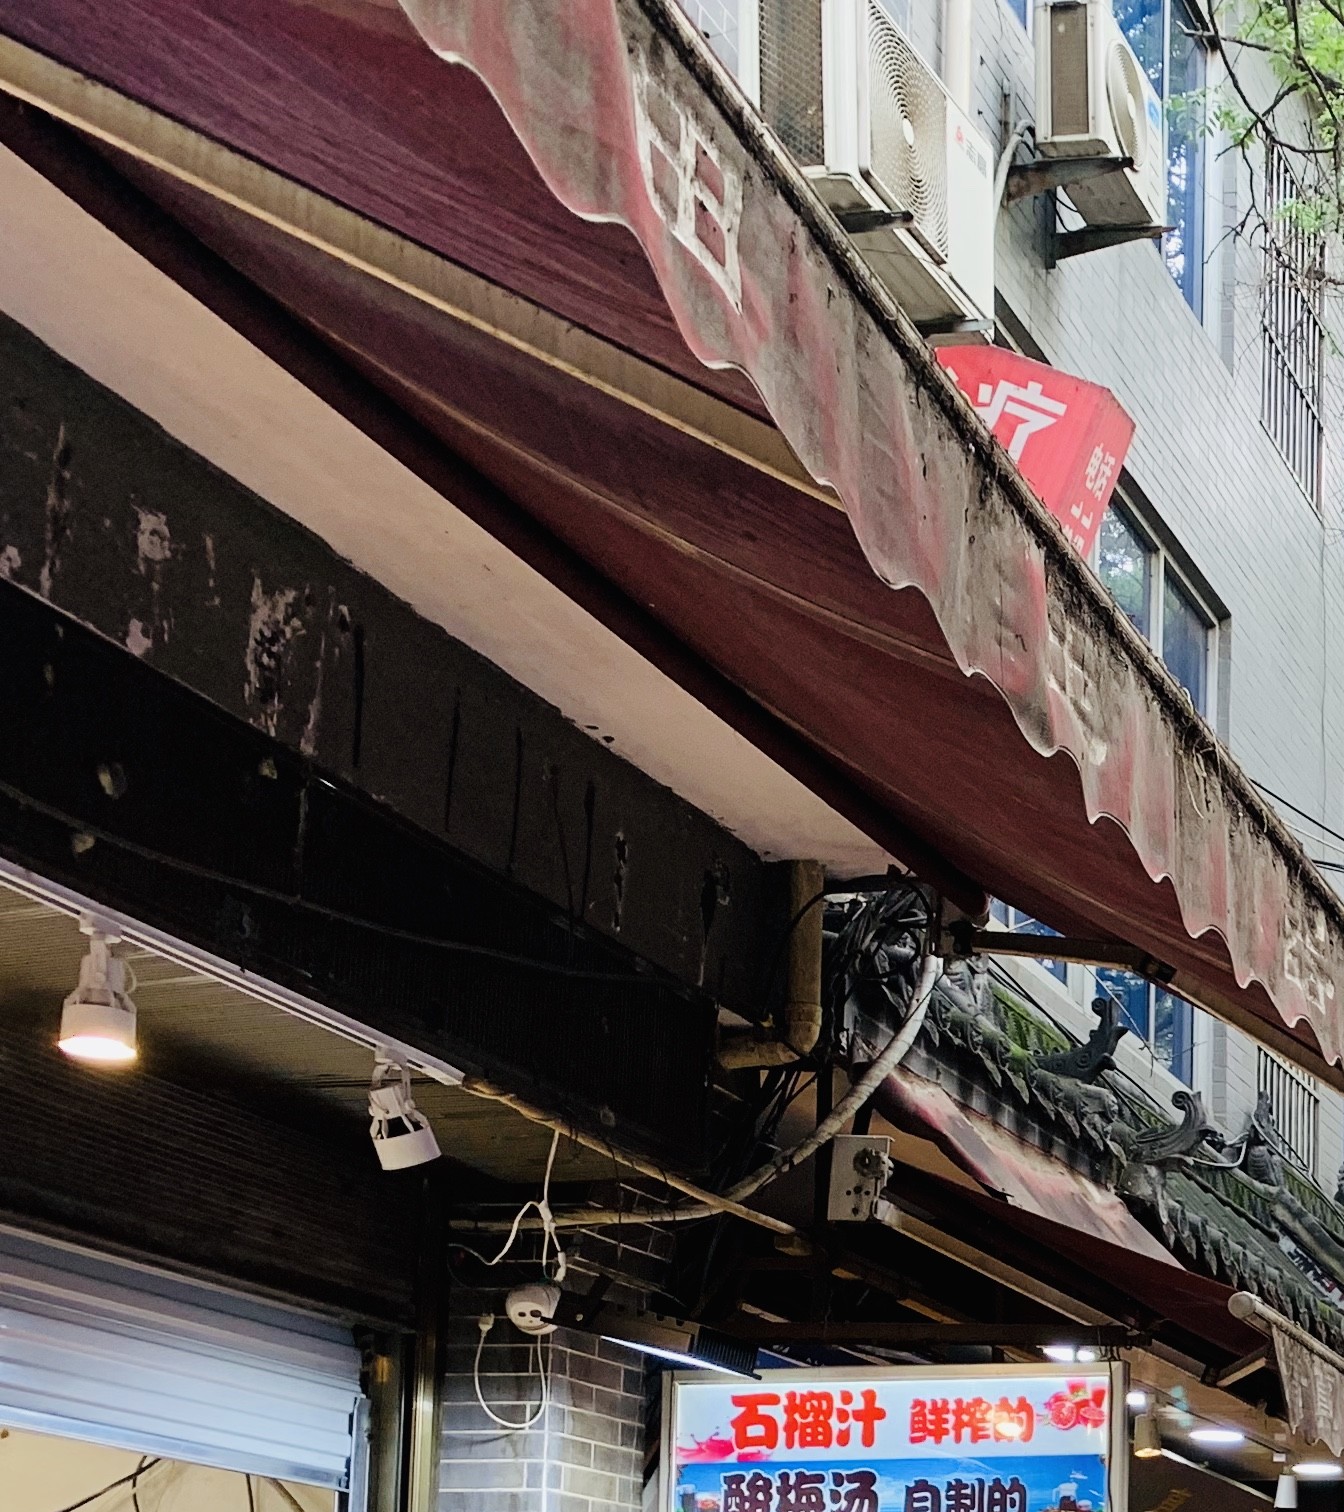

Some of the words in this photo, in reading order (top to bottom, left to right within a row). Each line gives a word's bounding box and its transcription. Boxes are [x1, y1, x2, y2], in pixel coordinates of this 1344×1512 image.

[730, 1389, 886, 1450] 石榴汁
[909, 1396, 1034, 1445] 鲜榨的
